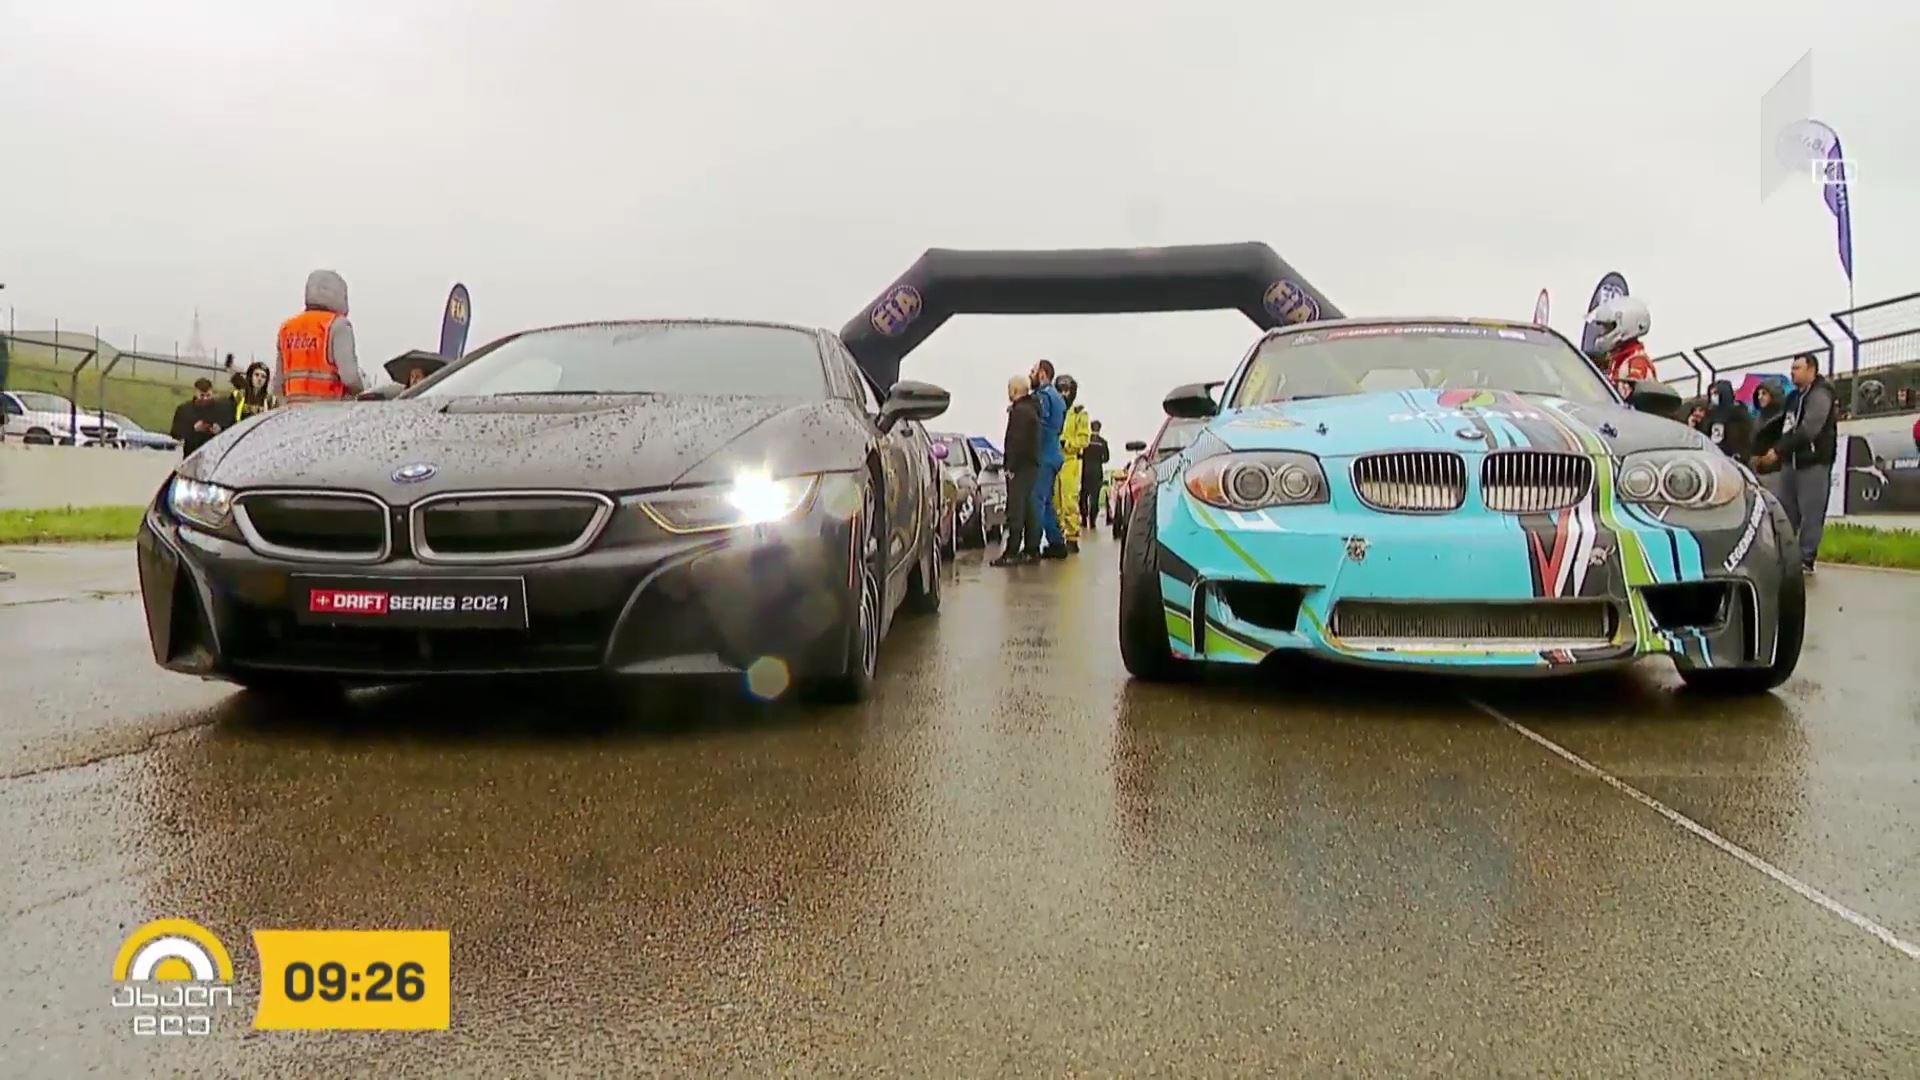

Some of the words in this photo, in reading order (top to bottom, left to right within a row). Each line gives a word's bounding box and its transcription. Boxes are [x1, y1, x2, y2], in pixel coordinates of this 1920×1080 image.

[873, 292, 916, 333] FIA
[1266, 280, 1311, 322] FIA
[332, 593, 386, 610] DRIFT
[389, 595, 456, 611] SERIES
[460, 595, 510, 611] 2021
